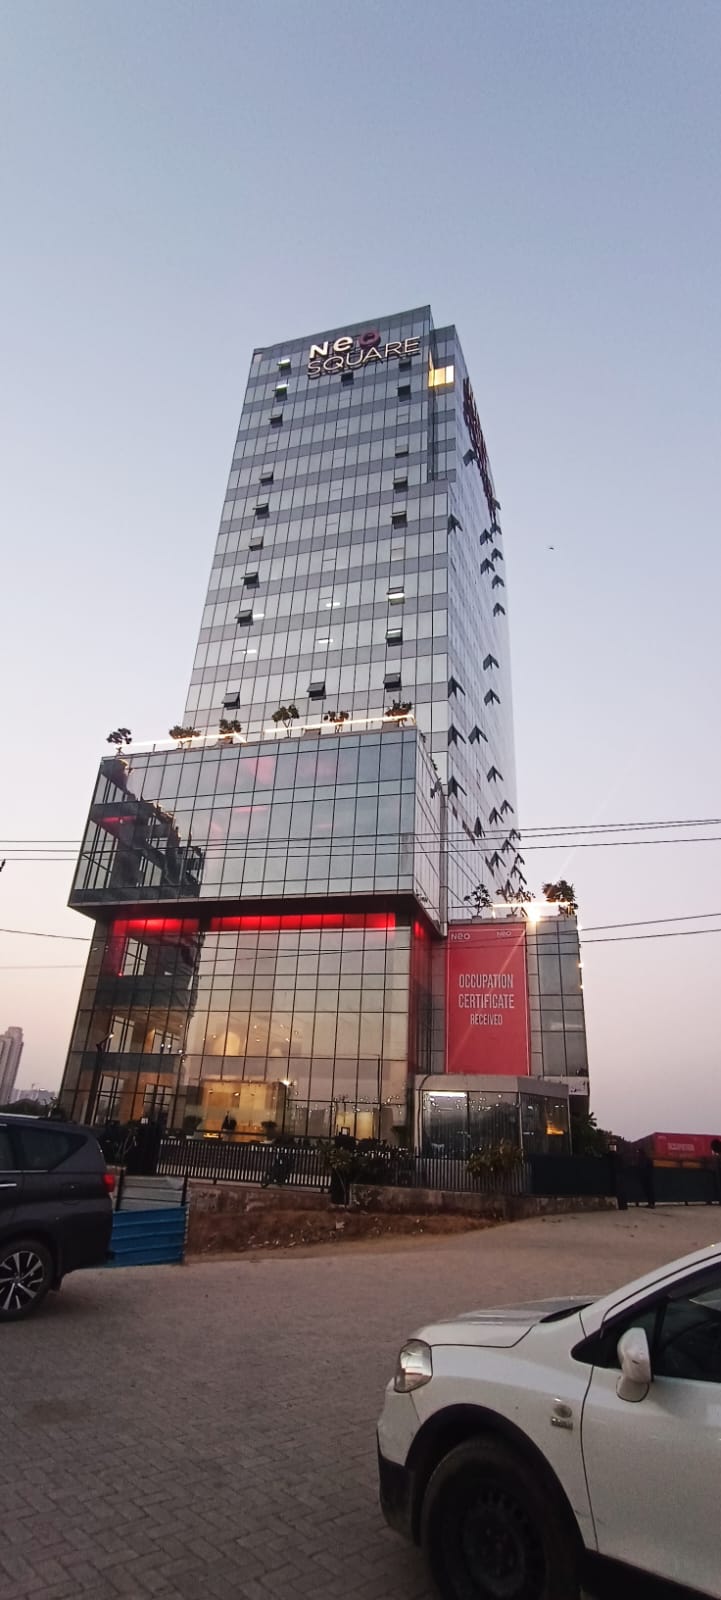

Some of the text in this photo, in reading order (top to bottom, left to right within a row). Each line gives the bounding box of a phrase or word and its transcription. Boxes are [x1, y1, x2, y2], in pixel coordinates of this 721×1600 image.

[307, 336, 420, 377] SQUARE
[458, 973, 514, 989] OCCUPATION
[458, 993, 515, 1009] CERTIFICATE
[470, 1013, 504, 1025] RECEIVED
